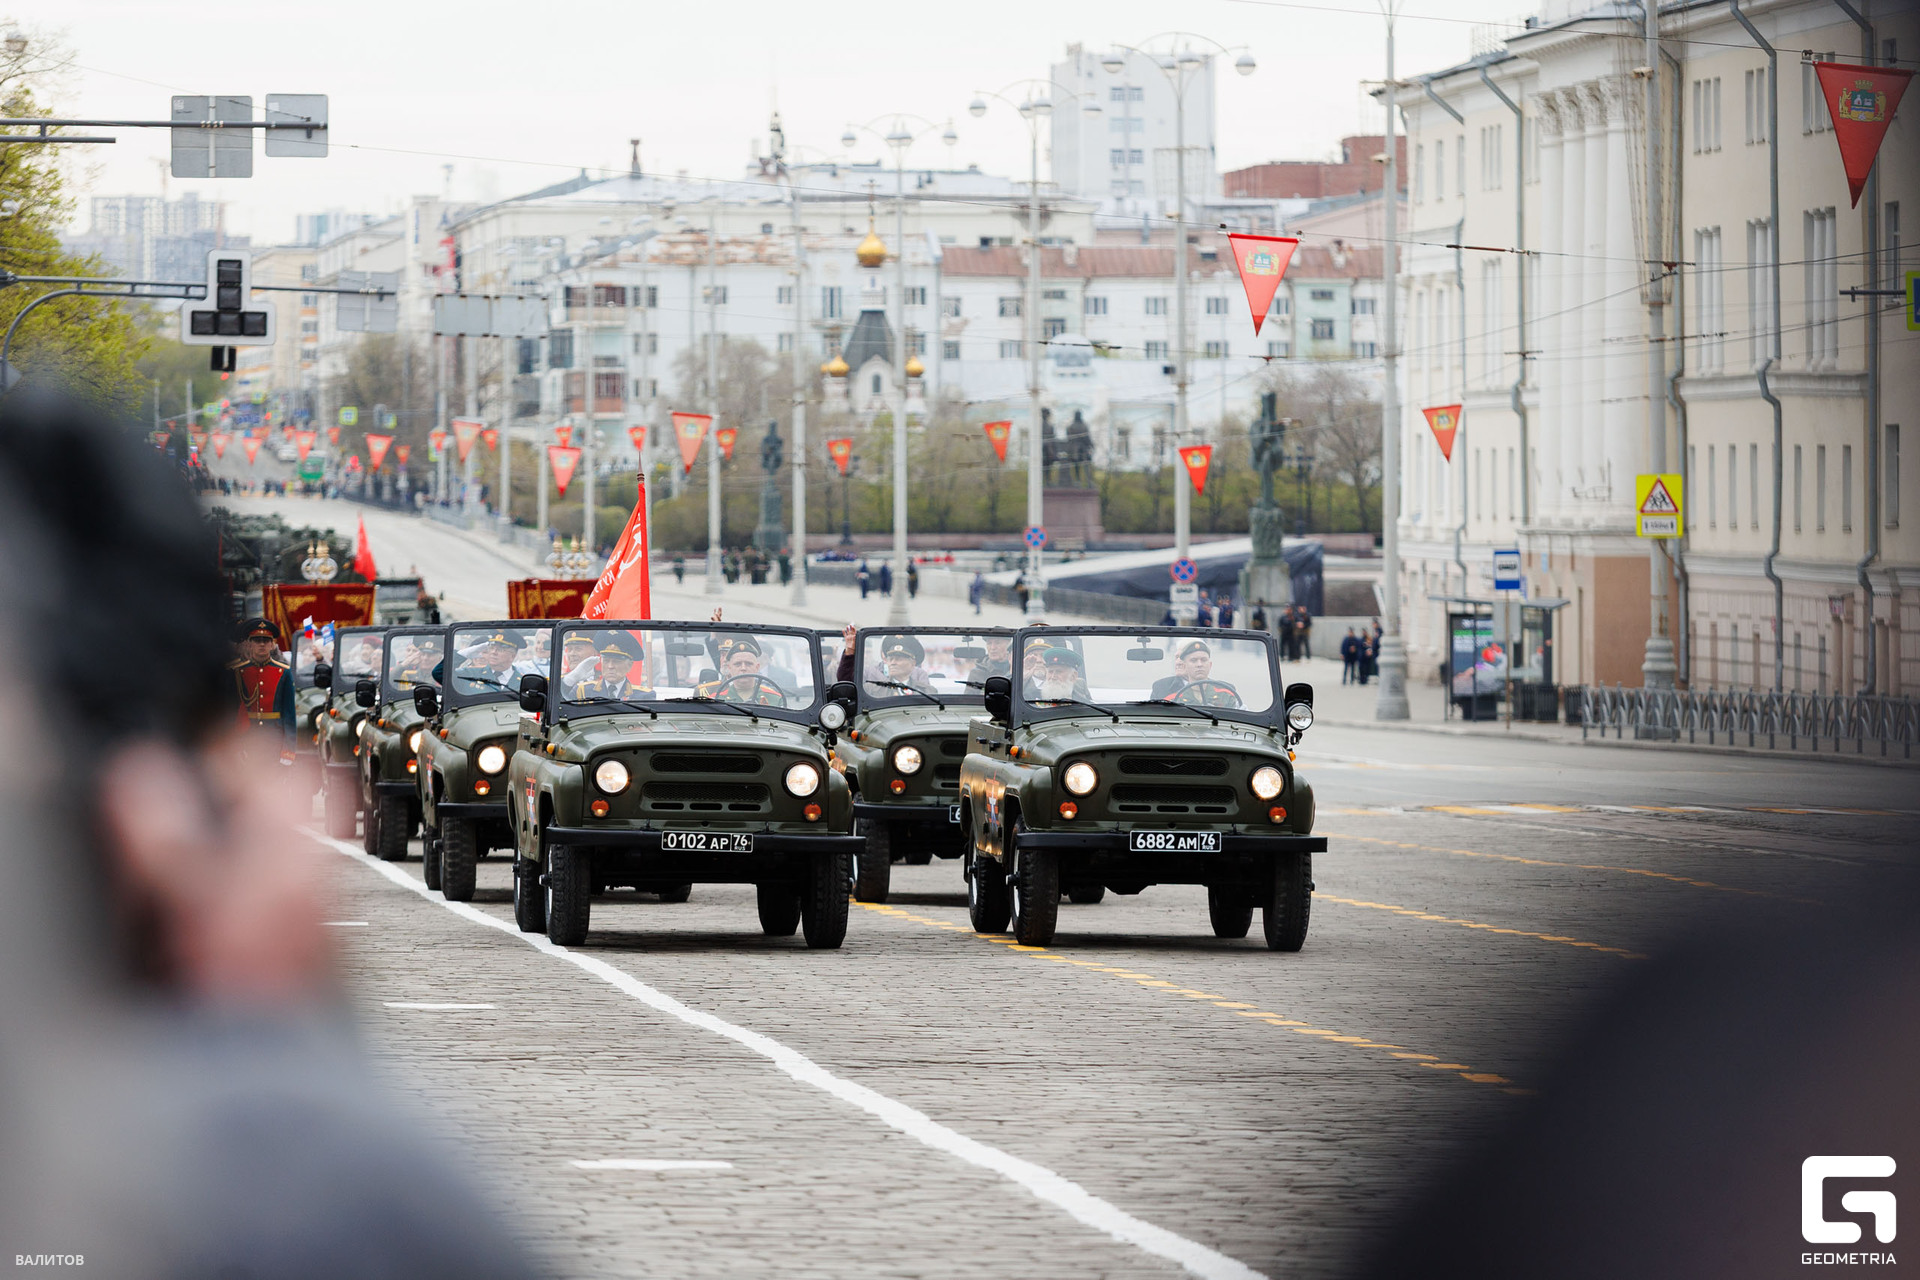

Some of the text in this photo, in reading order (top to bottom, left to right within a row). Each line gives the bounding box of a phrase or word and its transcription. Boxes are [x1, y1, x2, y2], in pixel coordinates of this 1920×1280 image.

[667, 833, 706, 849] 0102
[733, 834, 748, 846] 76
[1136, 833, 1175, 849] 6882
[1200, 834, 1216, 845] 76
